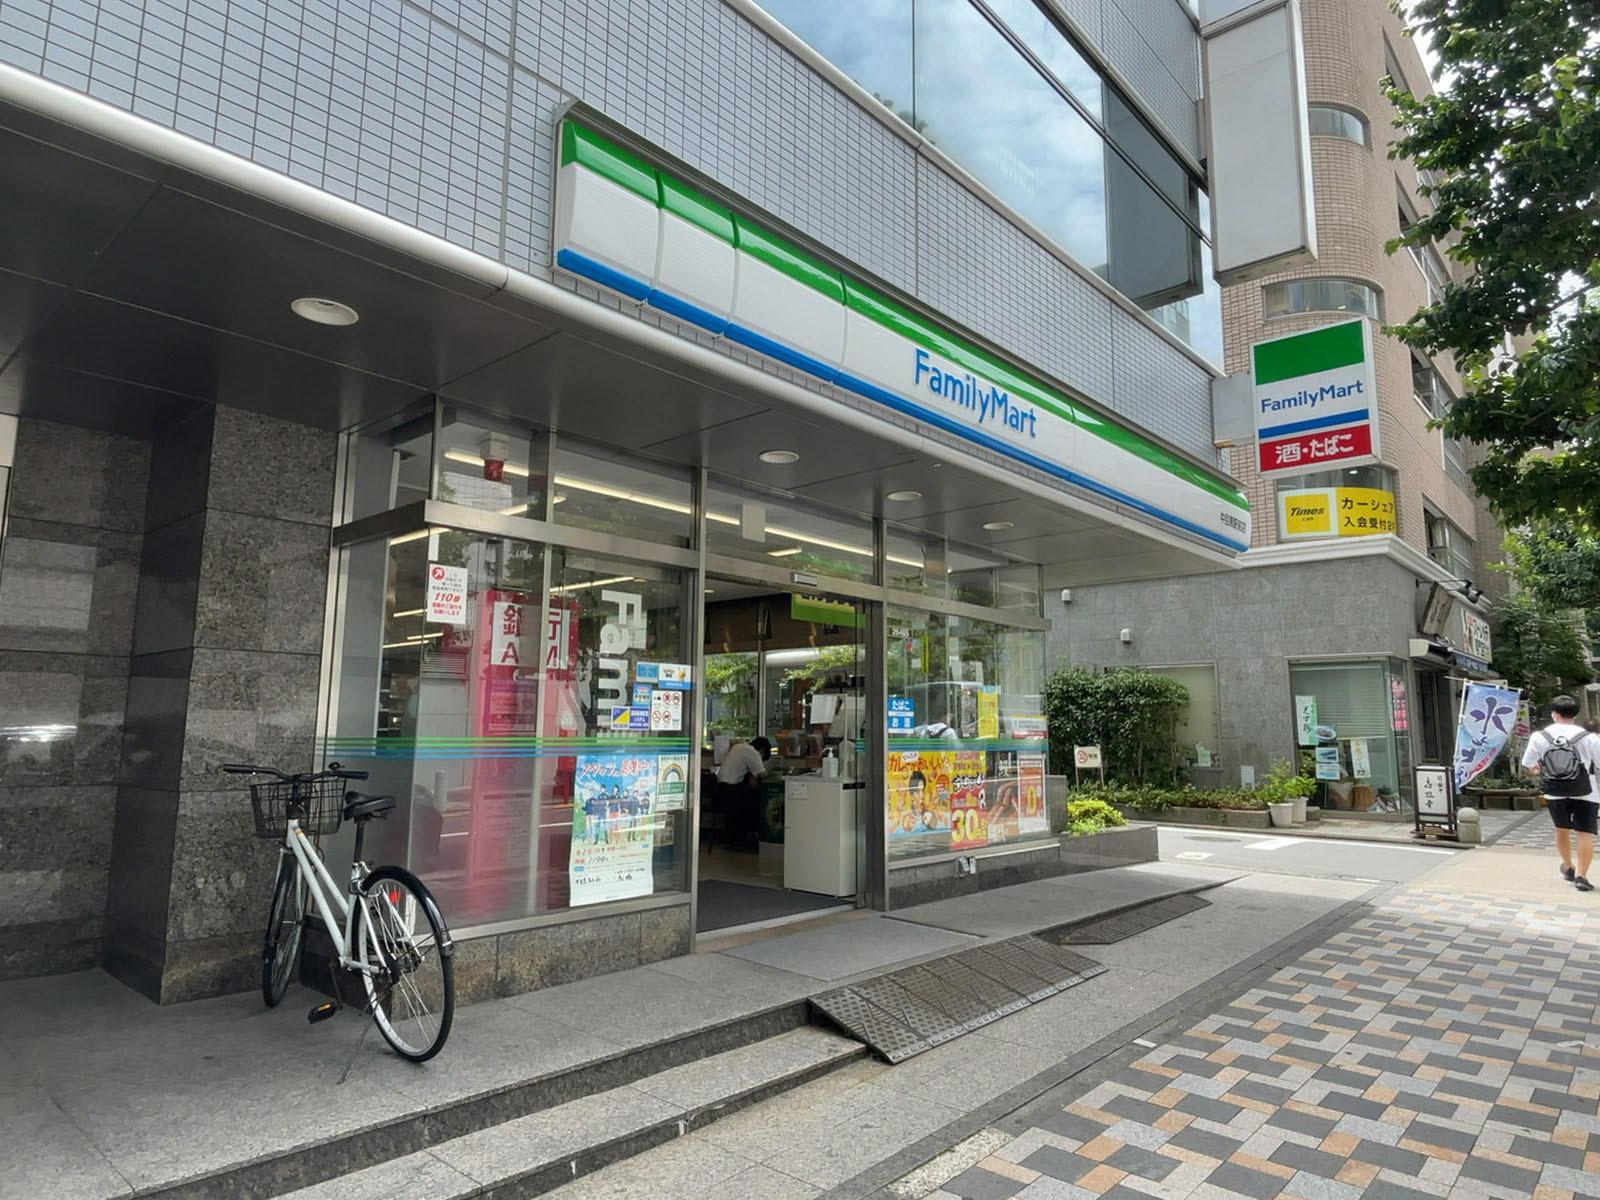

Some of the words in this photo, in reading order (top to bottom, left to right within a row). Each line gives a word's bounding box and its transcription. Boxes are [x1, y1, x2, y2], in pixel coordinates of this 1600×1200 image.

[915, 348, 1037, 438] FamilyMart
[1261, 380, 1363, 413] FamilyMart
[1275, 434, 1354, 464] 酒・たばこ
[1290, 507, 1325, 517] Times
[892, 700, 911, 711] たばこ
